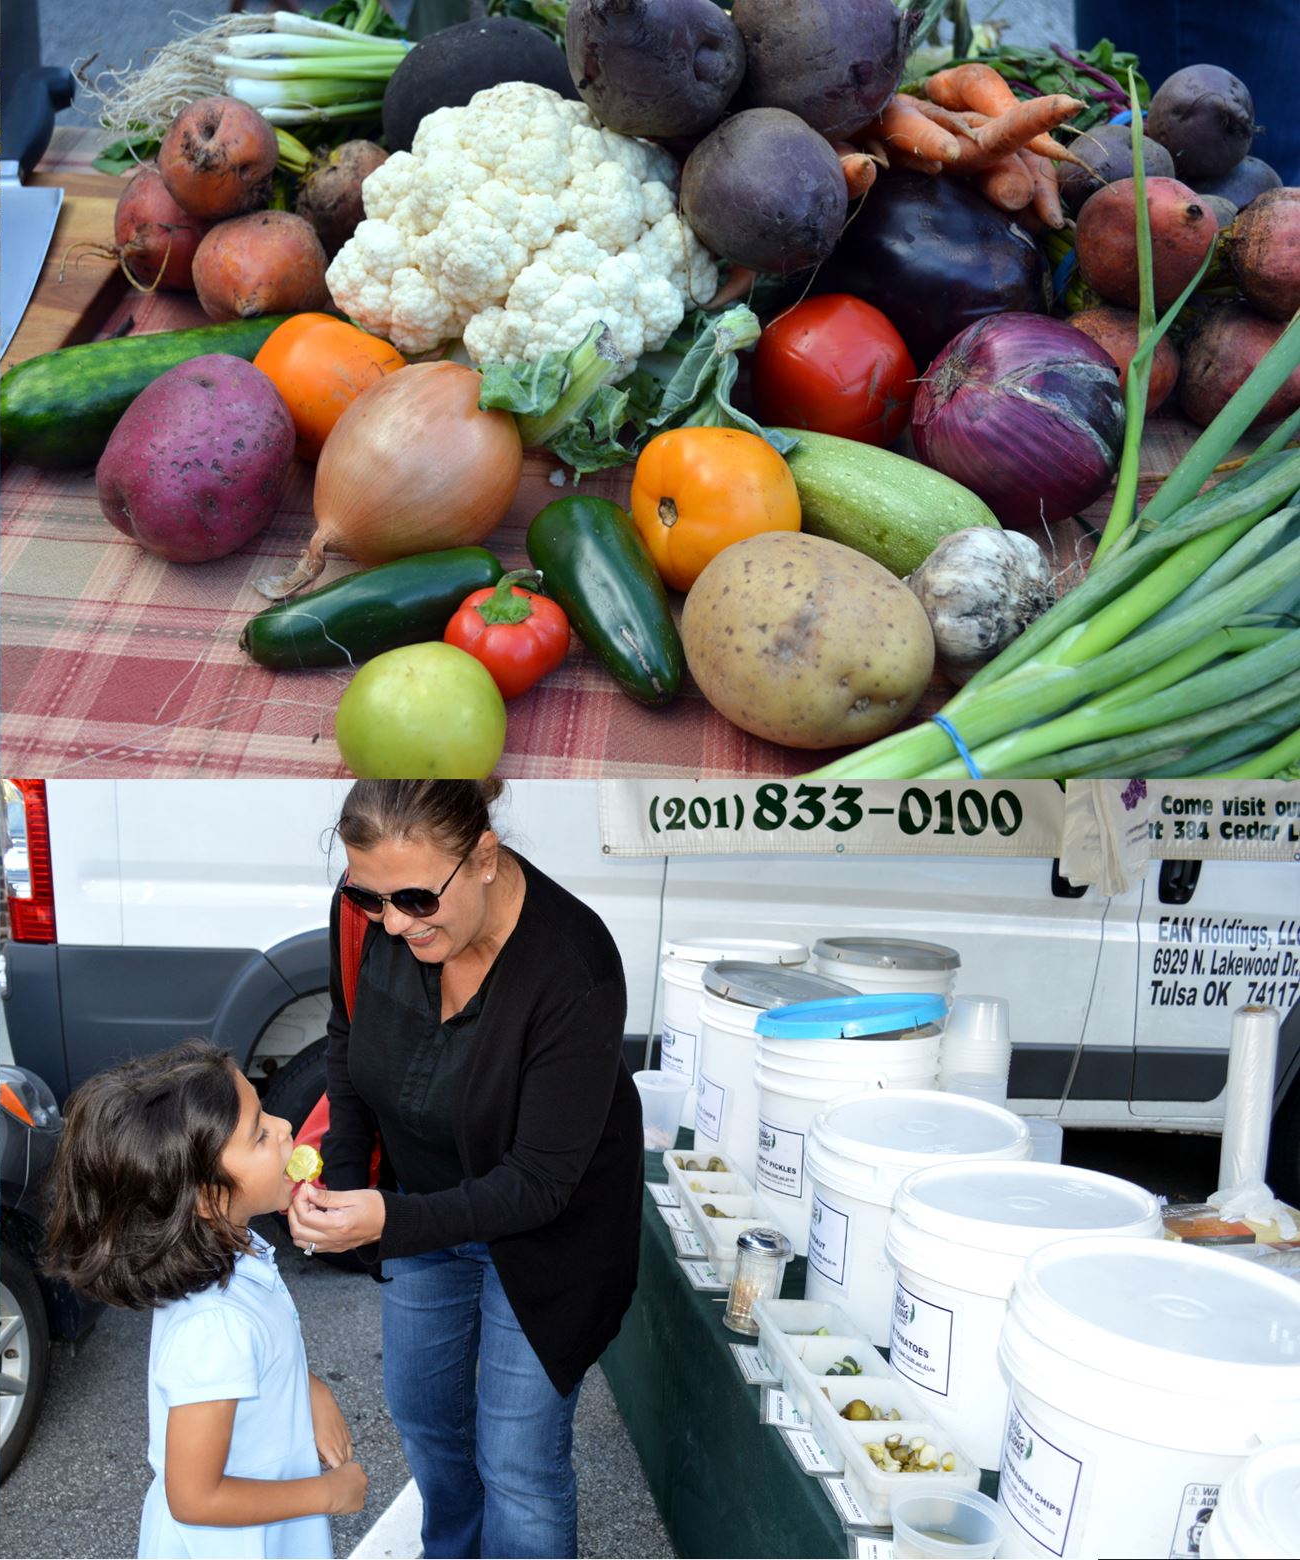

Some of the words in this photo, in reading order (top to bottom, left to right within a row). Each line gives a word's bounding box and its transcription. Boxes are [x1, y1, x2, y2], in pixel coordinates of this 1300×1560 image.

[648, 793, 745, 834] (201)
[752, 783, 1023, 837] 833-0100
[1161, 795, 1213, 816] Come
[1222, 797, 1266, 816] visit
[1174, 821, 1209, 840] 384
[1220, 822, 1280, 841] Cedar
[1288, 823, 1300, 842] L
[1158, 916, 1194, 943] EAN
[1199, 918, 1272, 951] Holdings,
[1153, 948, 1189, 975] 6929
[1191, 949, 1206, 975] N.
[1210, 950, 1281, 976] Lakewood
[1150, 980, 1198, 1007] Tulsa
[1203, 981, 1232, 1007] OK
[1247, 981, 1300, 1007] 74117
[769, 1159, 797, 1175] PICKLES
[895, 1328, 930, 1359] TOMATOES
[1034, 1492, 1062, 1517] CHIPS
